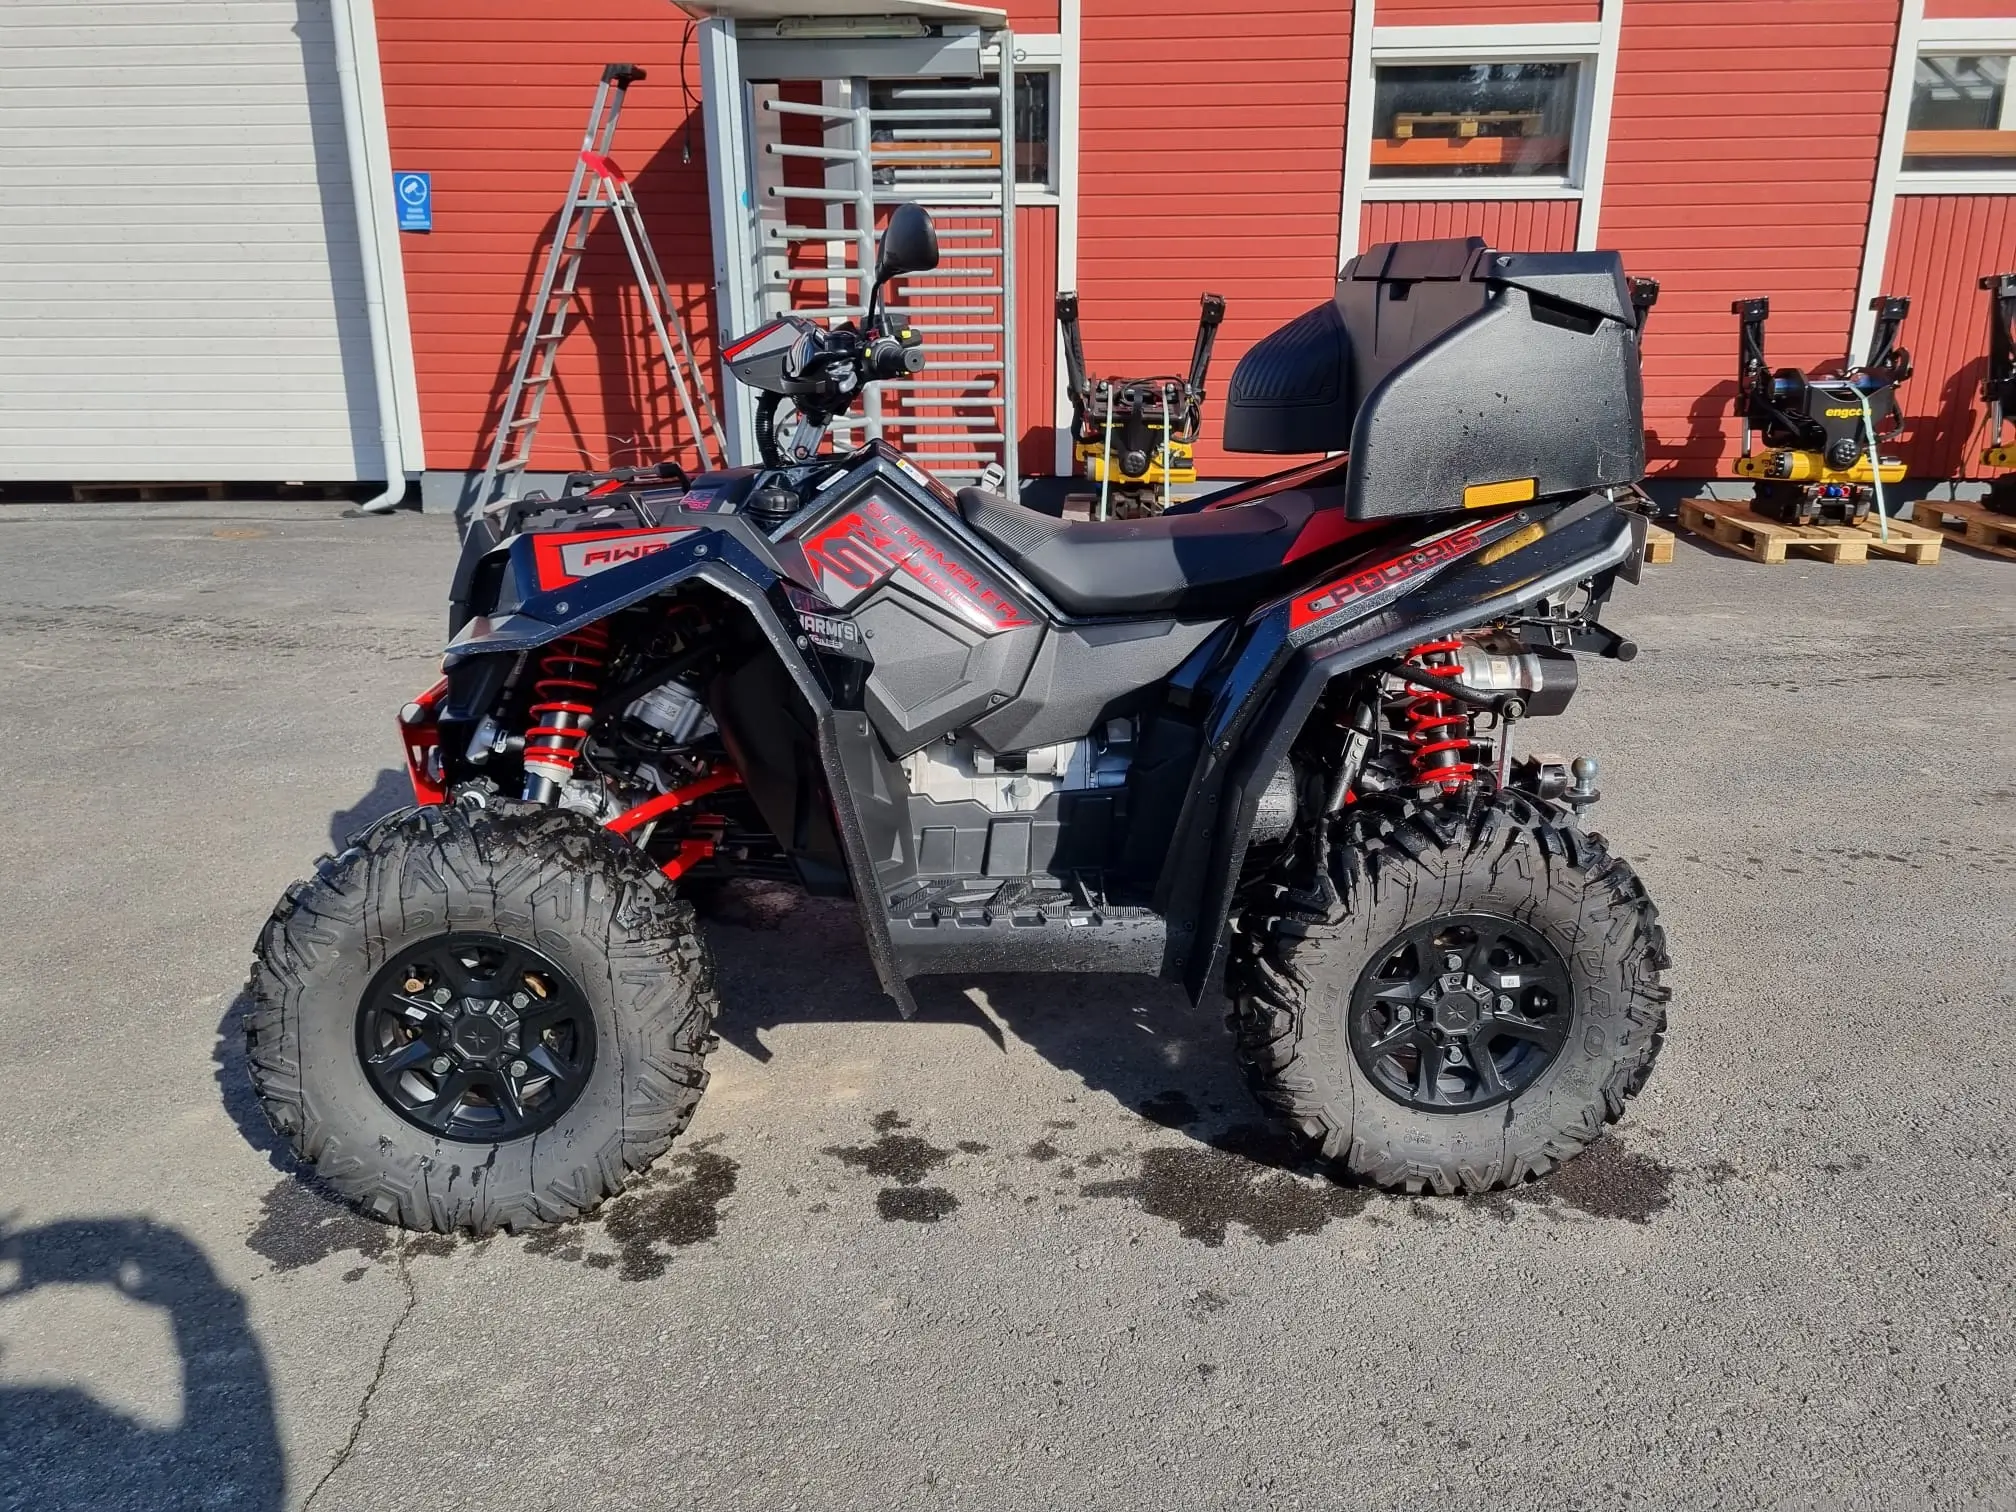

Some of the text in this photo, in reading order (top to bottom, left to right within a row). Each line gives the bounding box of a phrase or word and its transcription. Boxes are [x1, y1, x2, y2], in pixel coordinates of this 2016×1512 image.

[863, 501, 1022, 621] SCRAMBLER
[1328, 529, 1481, 606] POLARIS
[402, 904, 572, 952] DURO
[1551, 918, 1612, 1057] DURO
